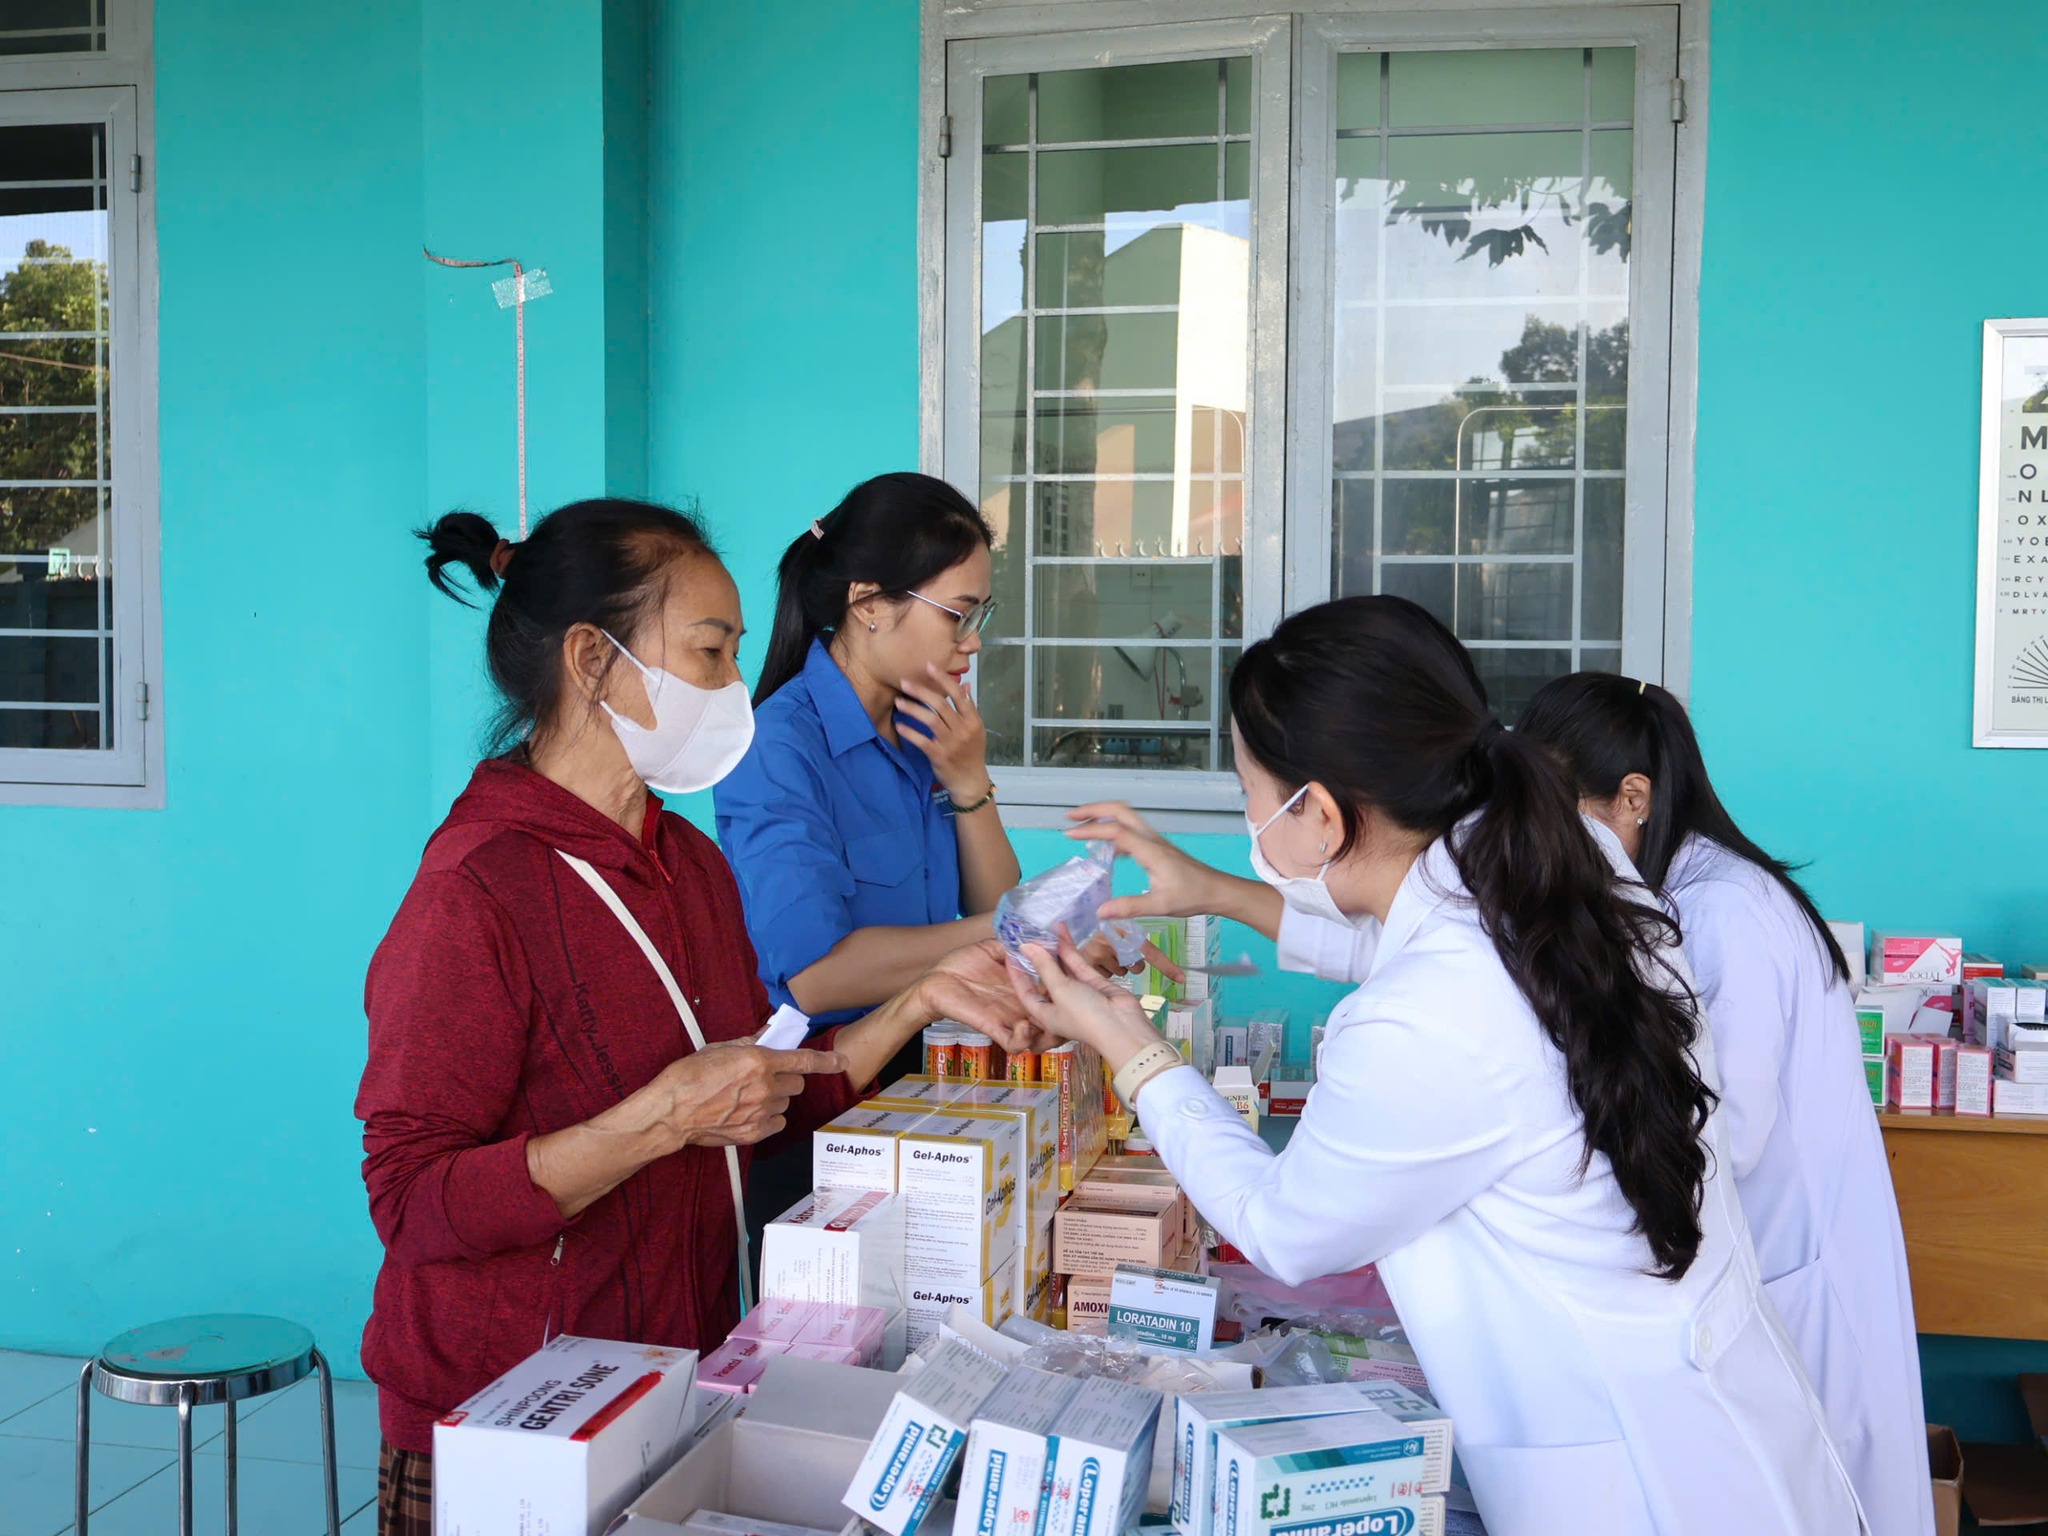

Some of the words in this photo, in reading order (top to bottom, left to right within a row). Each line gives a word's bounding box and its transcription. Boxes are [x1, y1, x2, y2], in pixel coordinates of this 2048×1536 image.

[1073, 1301, 1109, 1314] AMOXI
[1116, 1310, 1177, 1331] LORATADIN
[1179, 1321, 1192, 1333] 10
[495, 1378, 562, 1427] SHINPOONG
[873, 1424, 921, 1503] Loperamid
[1075, 1466, 1098, 1536] Loperam
